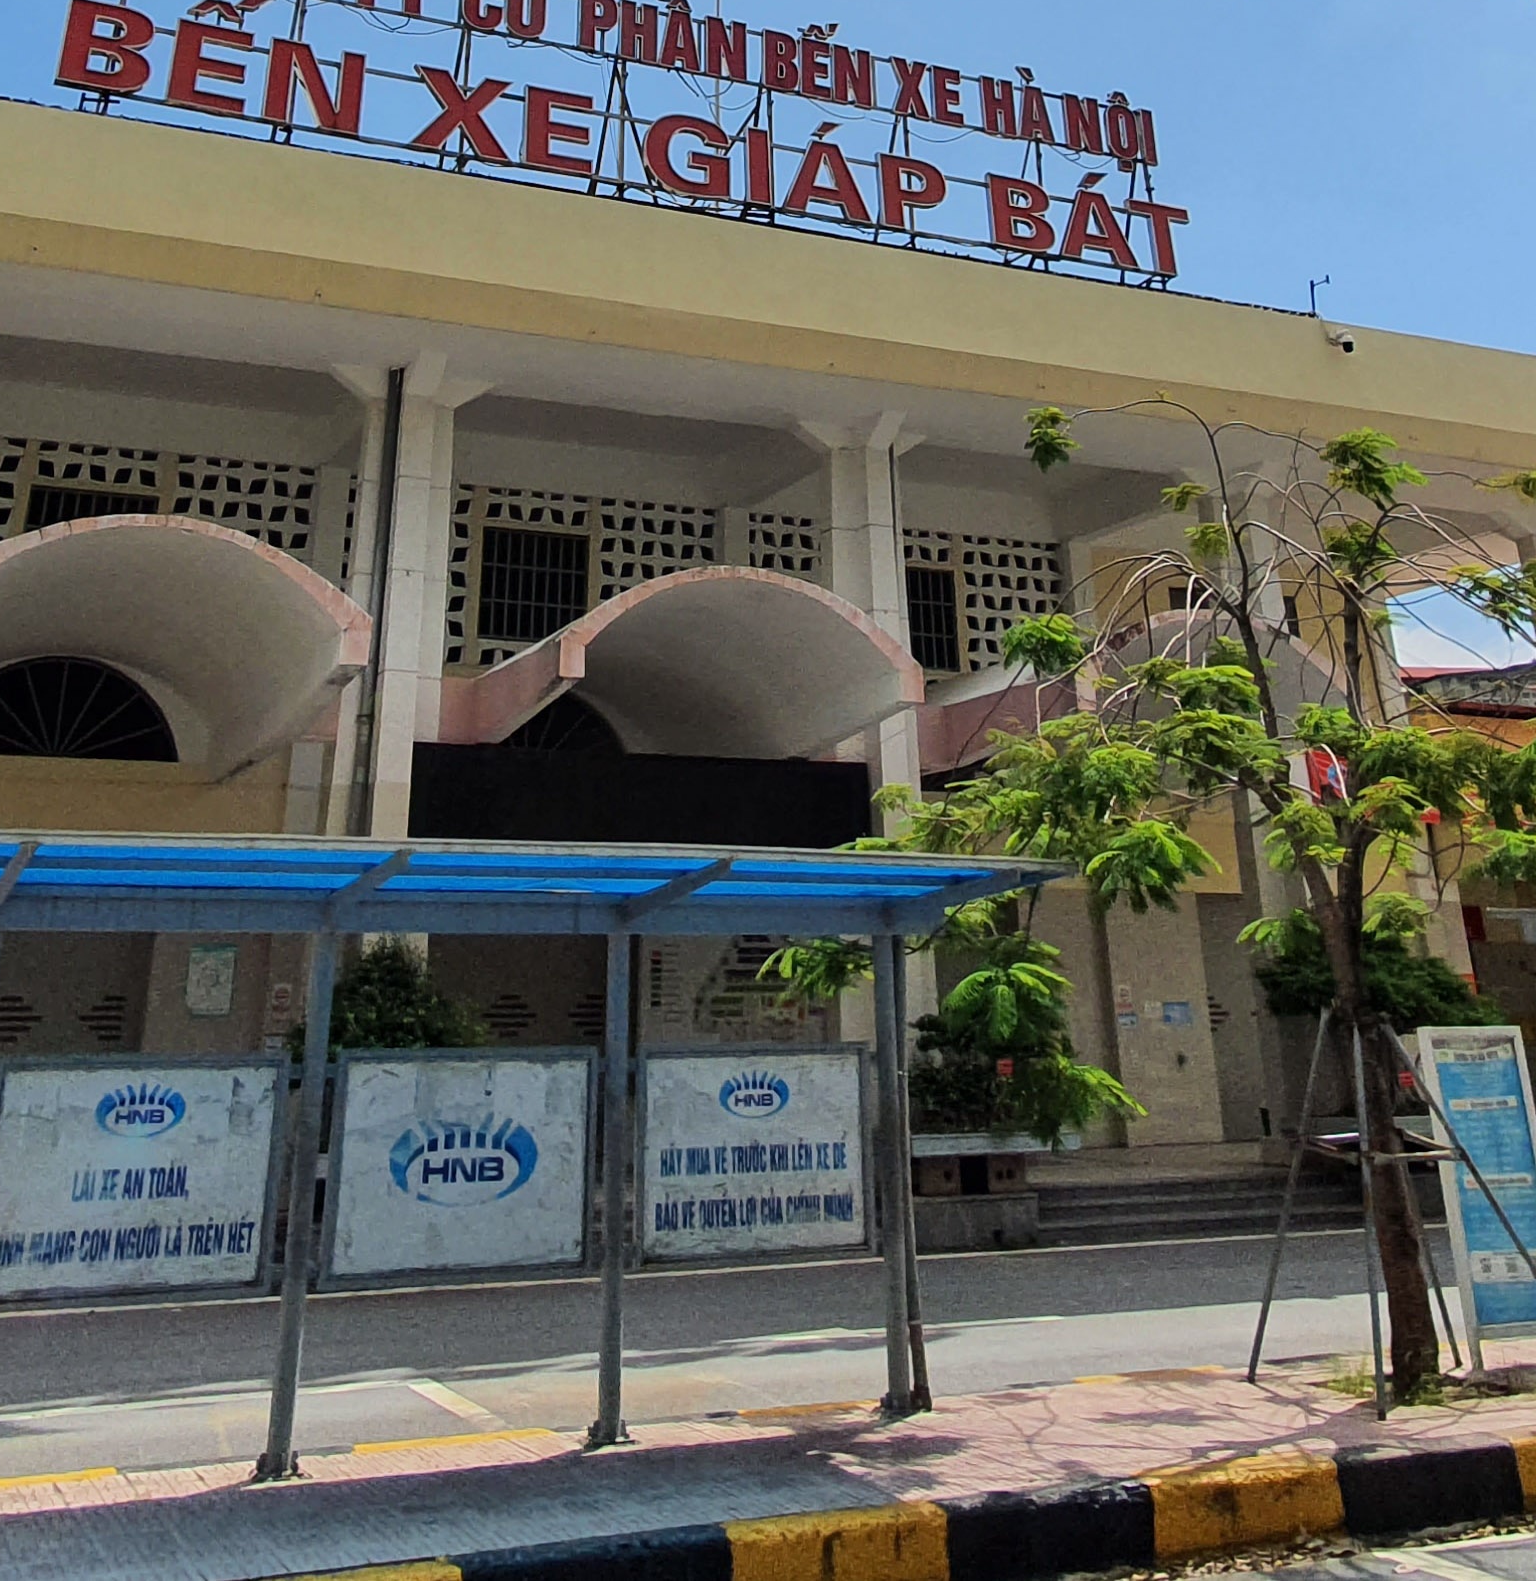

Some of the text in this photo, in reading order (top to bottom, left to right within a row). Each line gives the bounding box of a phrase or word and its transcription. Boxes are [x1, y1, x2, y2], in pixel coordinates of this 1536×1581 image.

[762, 22, 873, 110] BẾN
[890, 56, 964, 127] XE
[979, 66, 1055, 144] HÀ
[1062, 91, 1159, 173] NỘI
[409, 64, 595, 175] XE
[643, 114, 948, 230] GIÁP
[986, 172, 1190, 278] BÁT
[733, 1093, 774, 1107] HNB
[114, 1109, 165, 1125] HNB
[421, 1156, 505, 1185] HNB
[769, 1144, 789, 1172] KHI
[816, 1142, 831, 1171] XE
[99, 1168, 121, 1201] XE
[122, 1168, 144, 1199] AN
[187, 1217, 226, 1257] TRÊN
